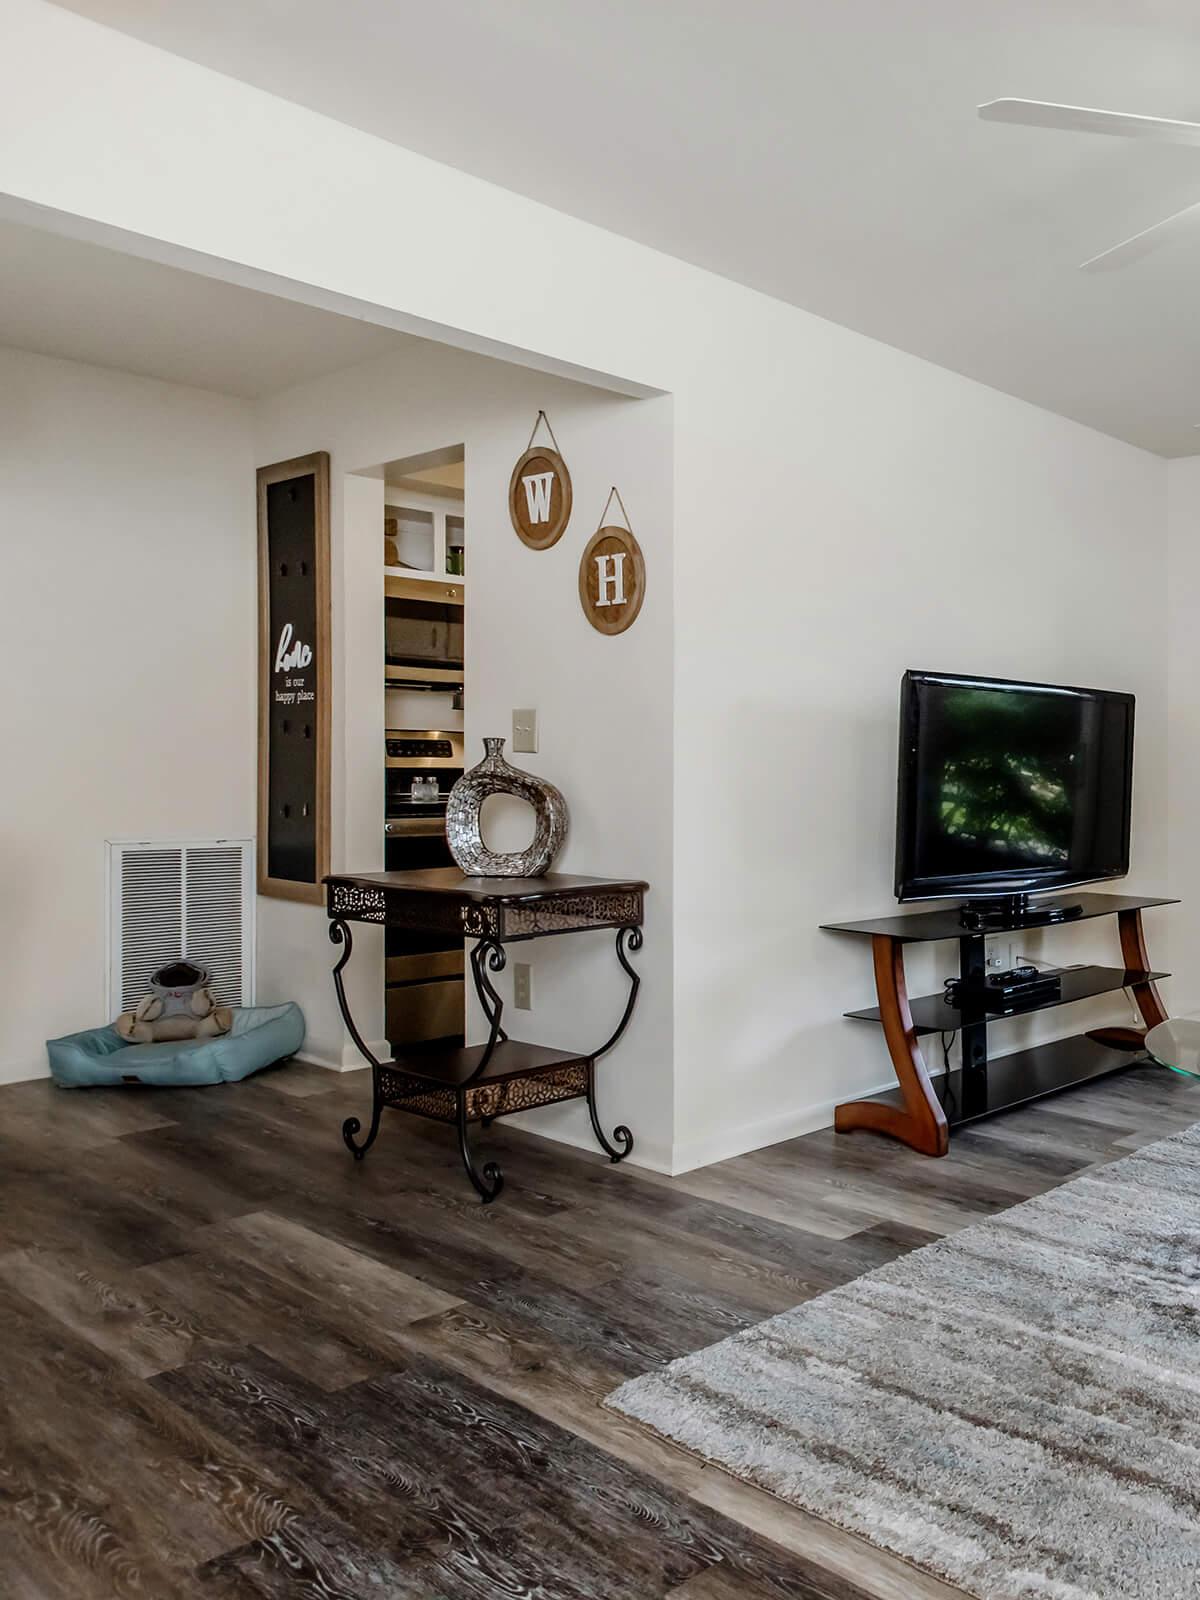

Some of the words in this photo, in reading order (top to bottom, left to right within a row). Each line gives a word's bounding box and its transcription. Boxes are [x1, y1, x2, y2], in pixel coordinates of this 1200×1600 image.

[522, 472, 554, 524] W
[594, 553, 627, 606] H
[275, 690, 296, 704] happy
[297, 690, 314, 704] place
[285, 676, 292, 687] is
[293, 678, 304, 687] our
